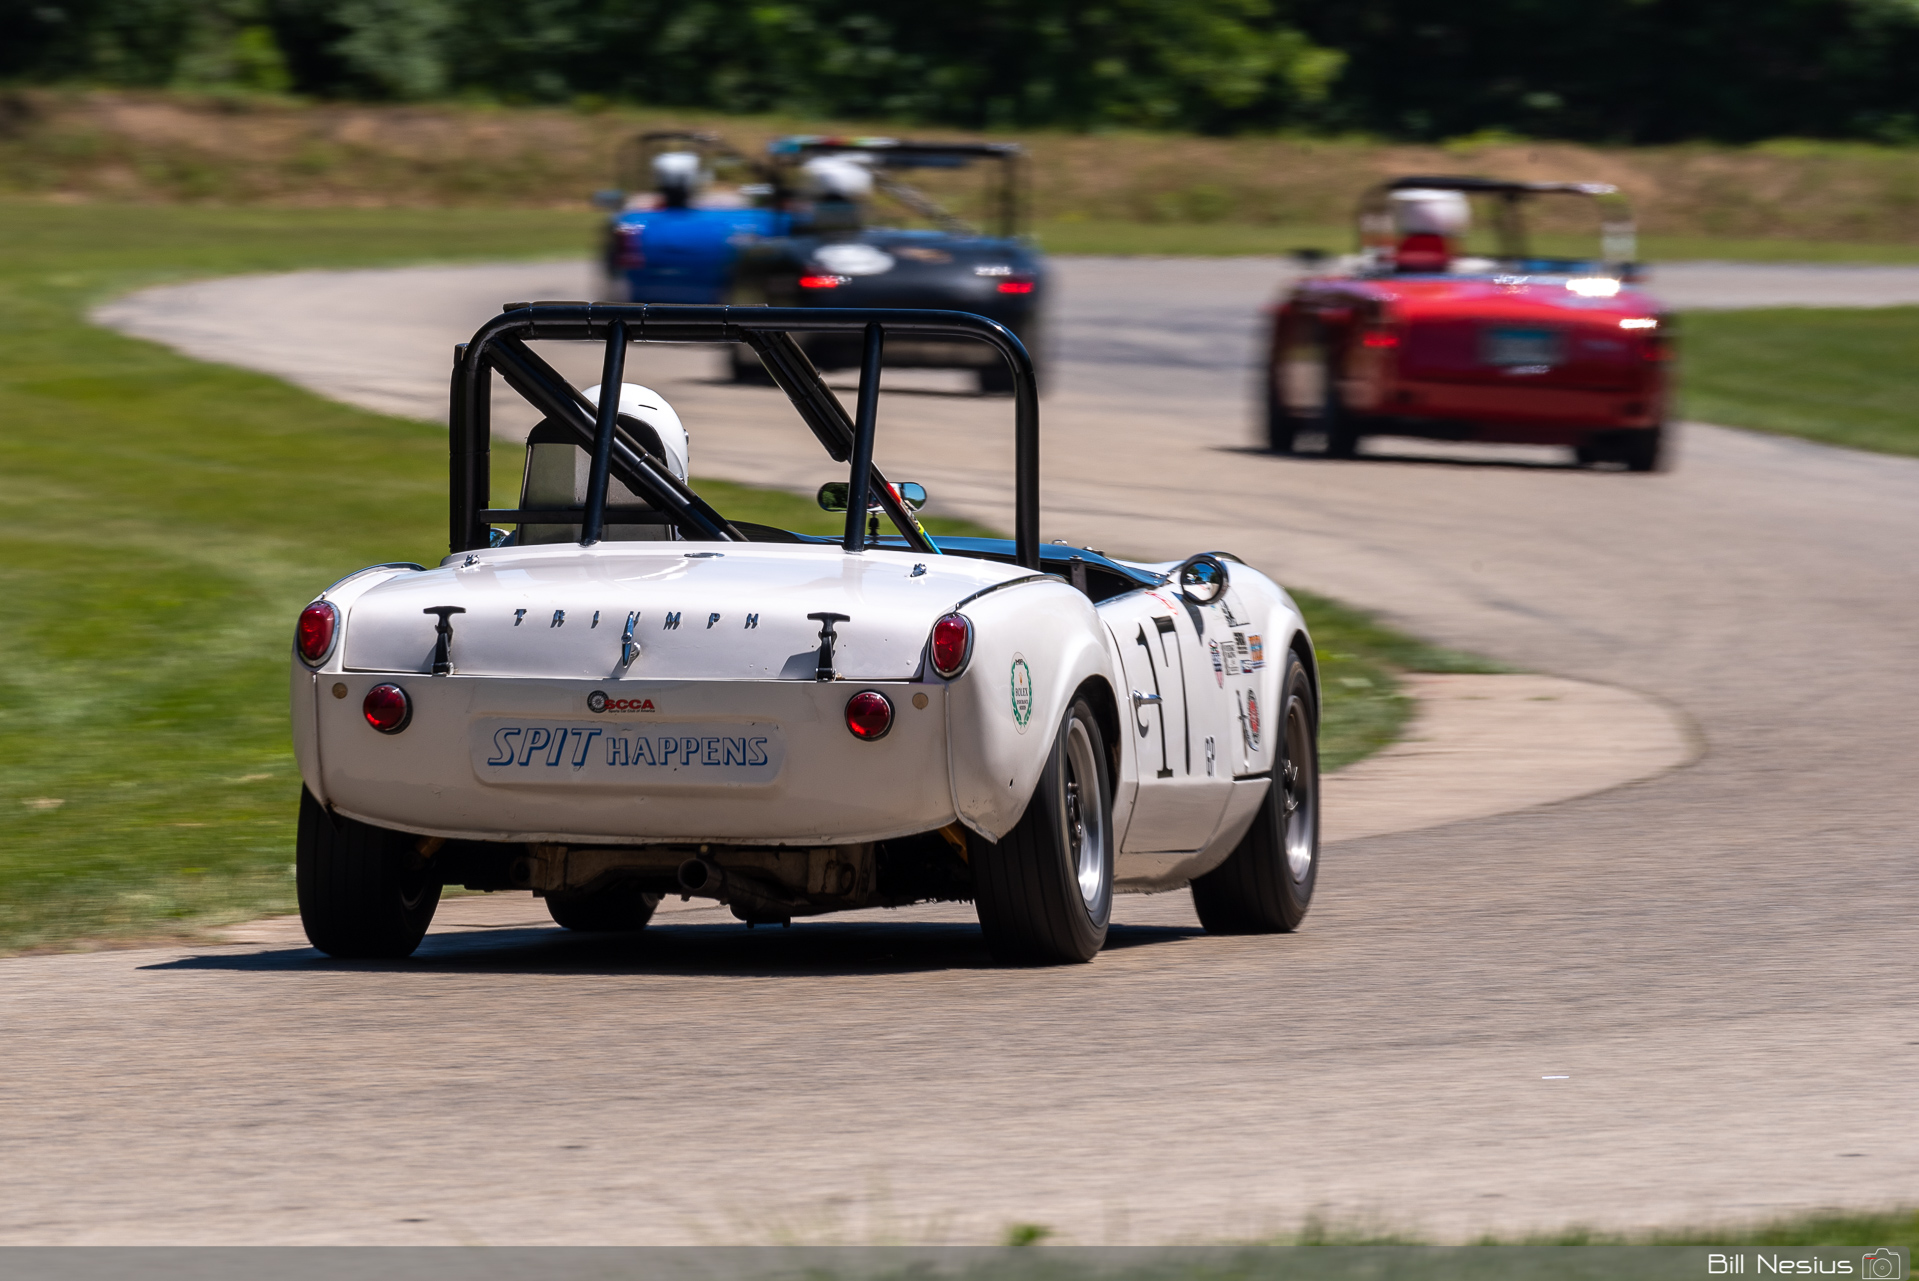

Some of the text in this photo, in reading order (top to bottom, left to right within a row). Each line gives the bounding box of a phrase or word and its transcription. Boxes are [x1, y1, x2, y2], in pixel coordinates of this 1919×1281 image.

[604, 699, 655, 709] SCCA
[1015, 687, 1029, 697] ROLEX
[1136, 615, 1190, 778] 17
[487, 727, 768, 767] SPIT HAPPENS
